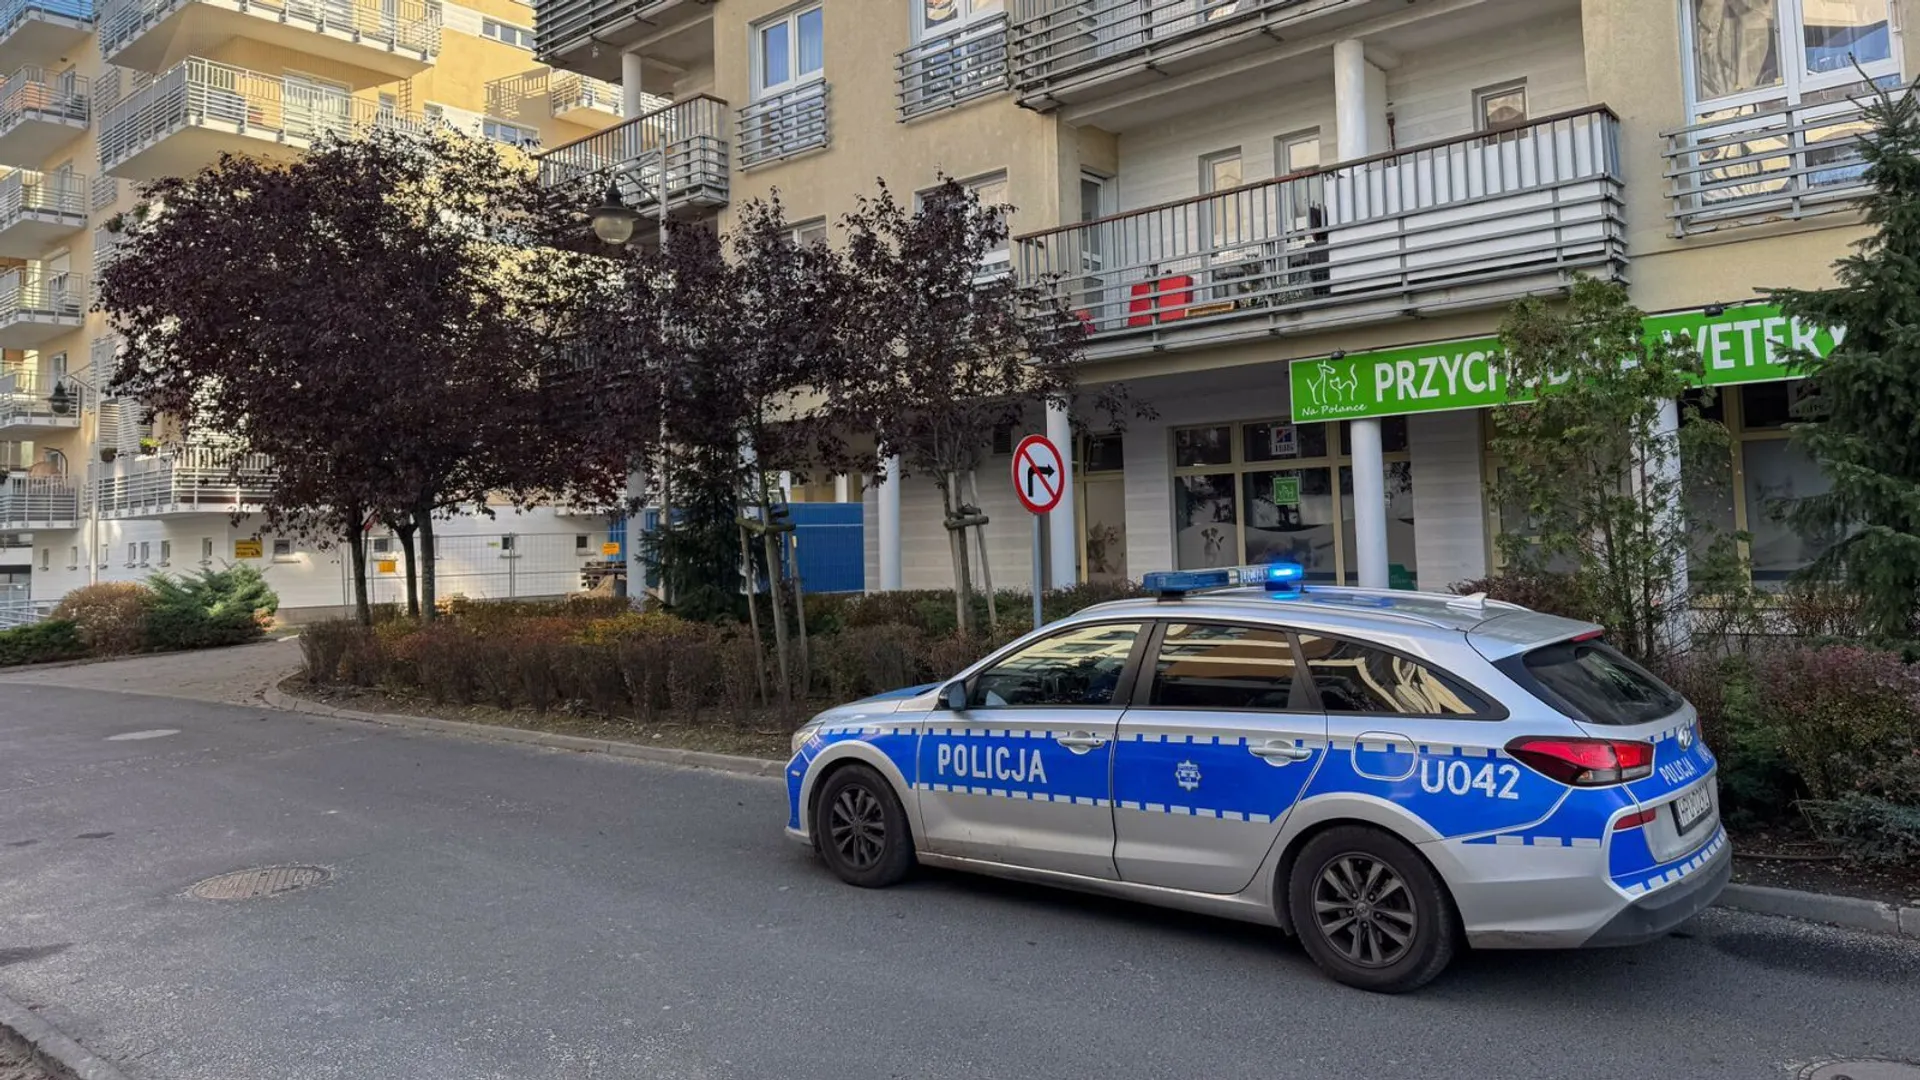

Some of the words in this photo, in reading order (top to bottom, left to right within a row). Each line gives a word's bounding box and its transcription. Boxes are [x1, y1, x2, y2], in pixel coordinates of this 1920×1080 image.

[1301, 406, 1318, 417] Na
[1321, 403, 1368, 415] Polance
[938, 743, 1048, 784] POLICJA
[1420, 759, 1520, 799] U042
[1659, 755, 1698, 786] POLICJA
